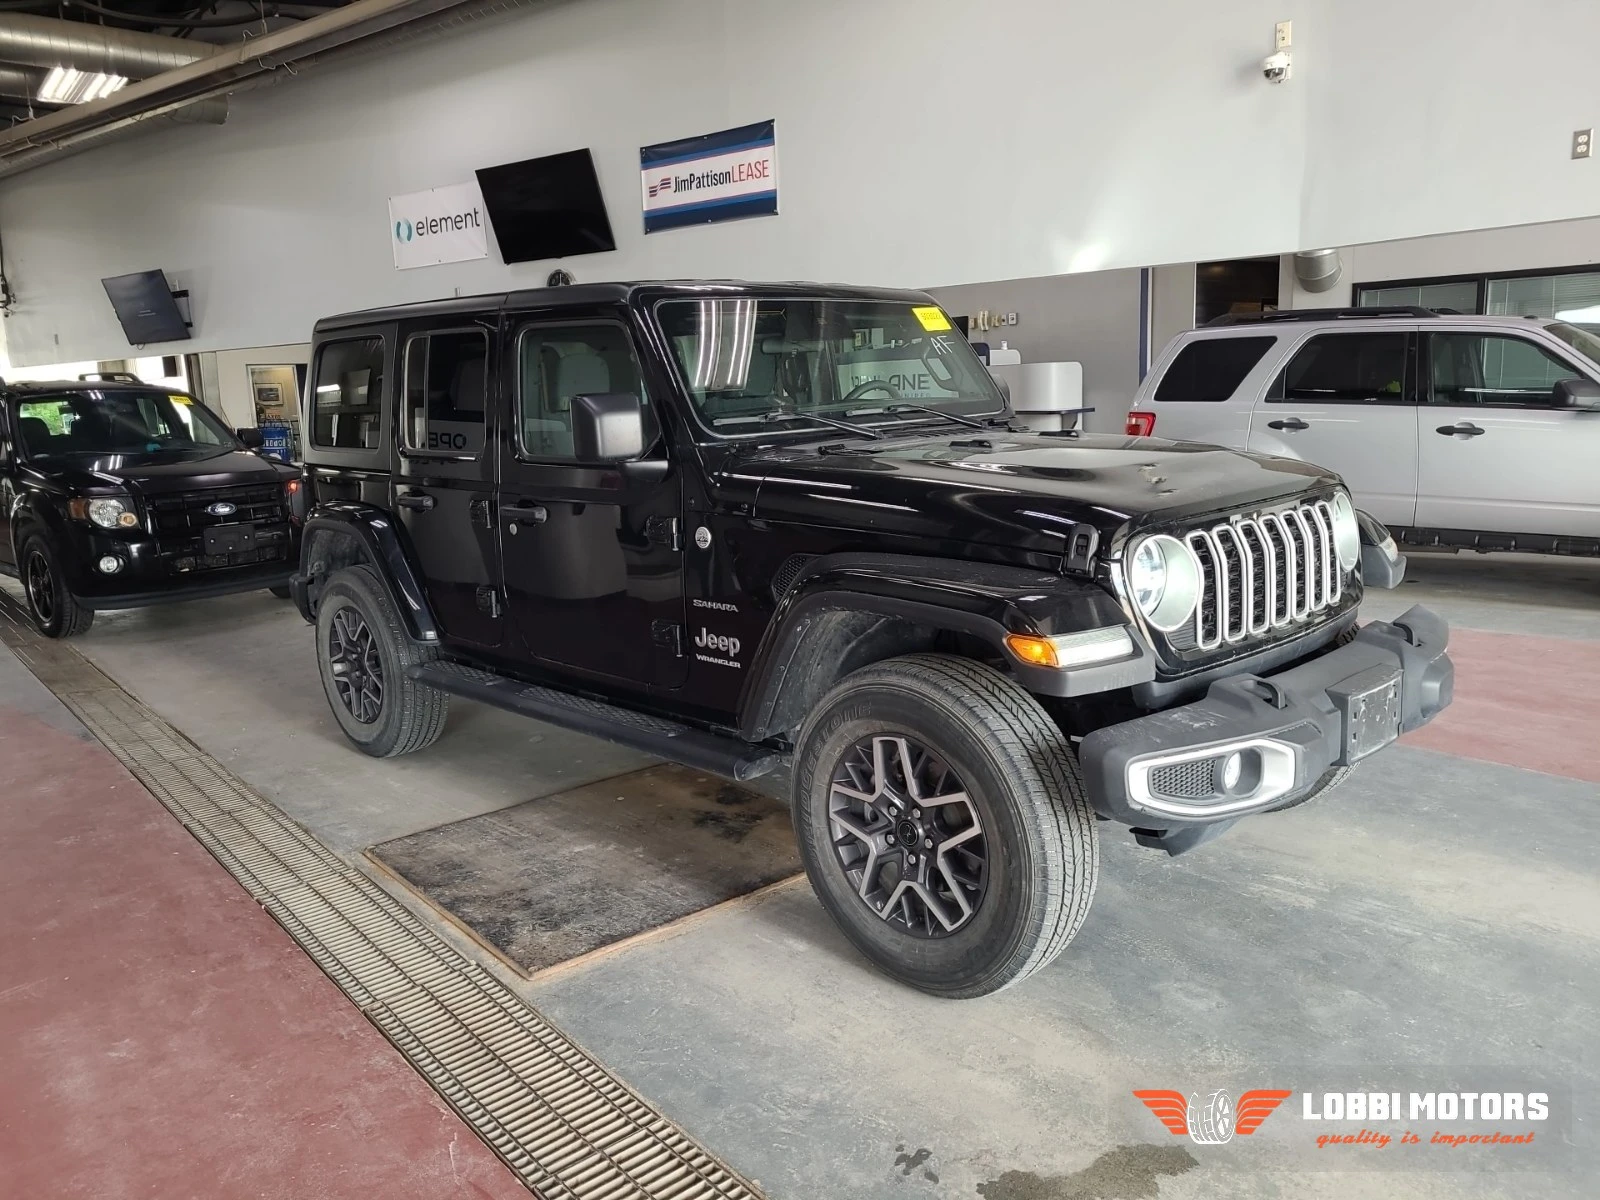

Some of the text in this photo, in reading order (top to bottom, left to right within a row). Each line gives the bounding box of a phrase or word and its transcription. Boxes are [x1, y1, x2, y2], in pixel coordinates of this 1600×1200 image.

[415, 207, 481, 237] element
[693, 599, 739, 613] SAHARA
[694, 627, 741, 657] Jeep
[696, 653, 741, 669] WRANGLER
